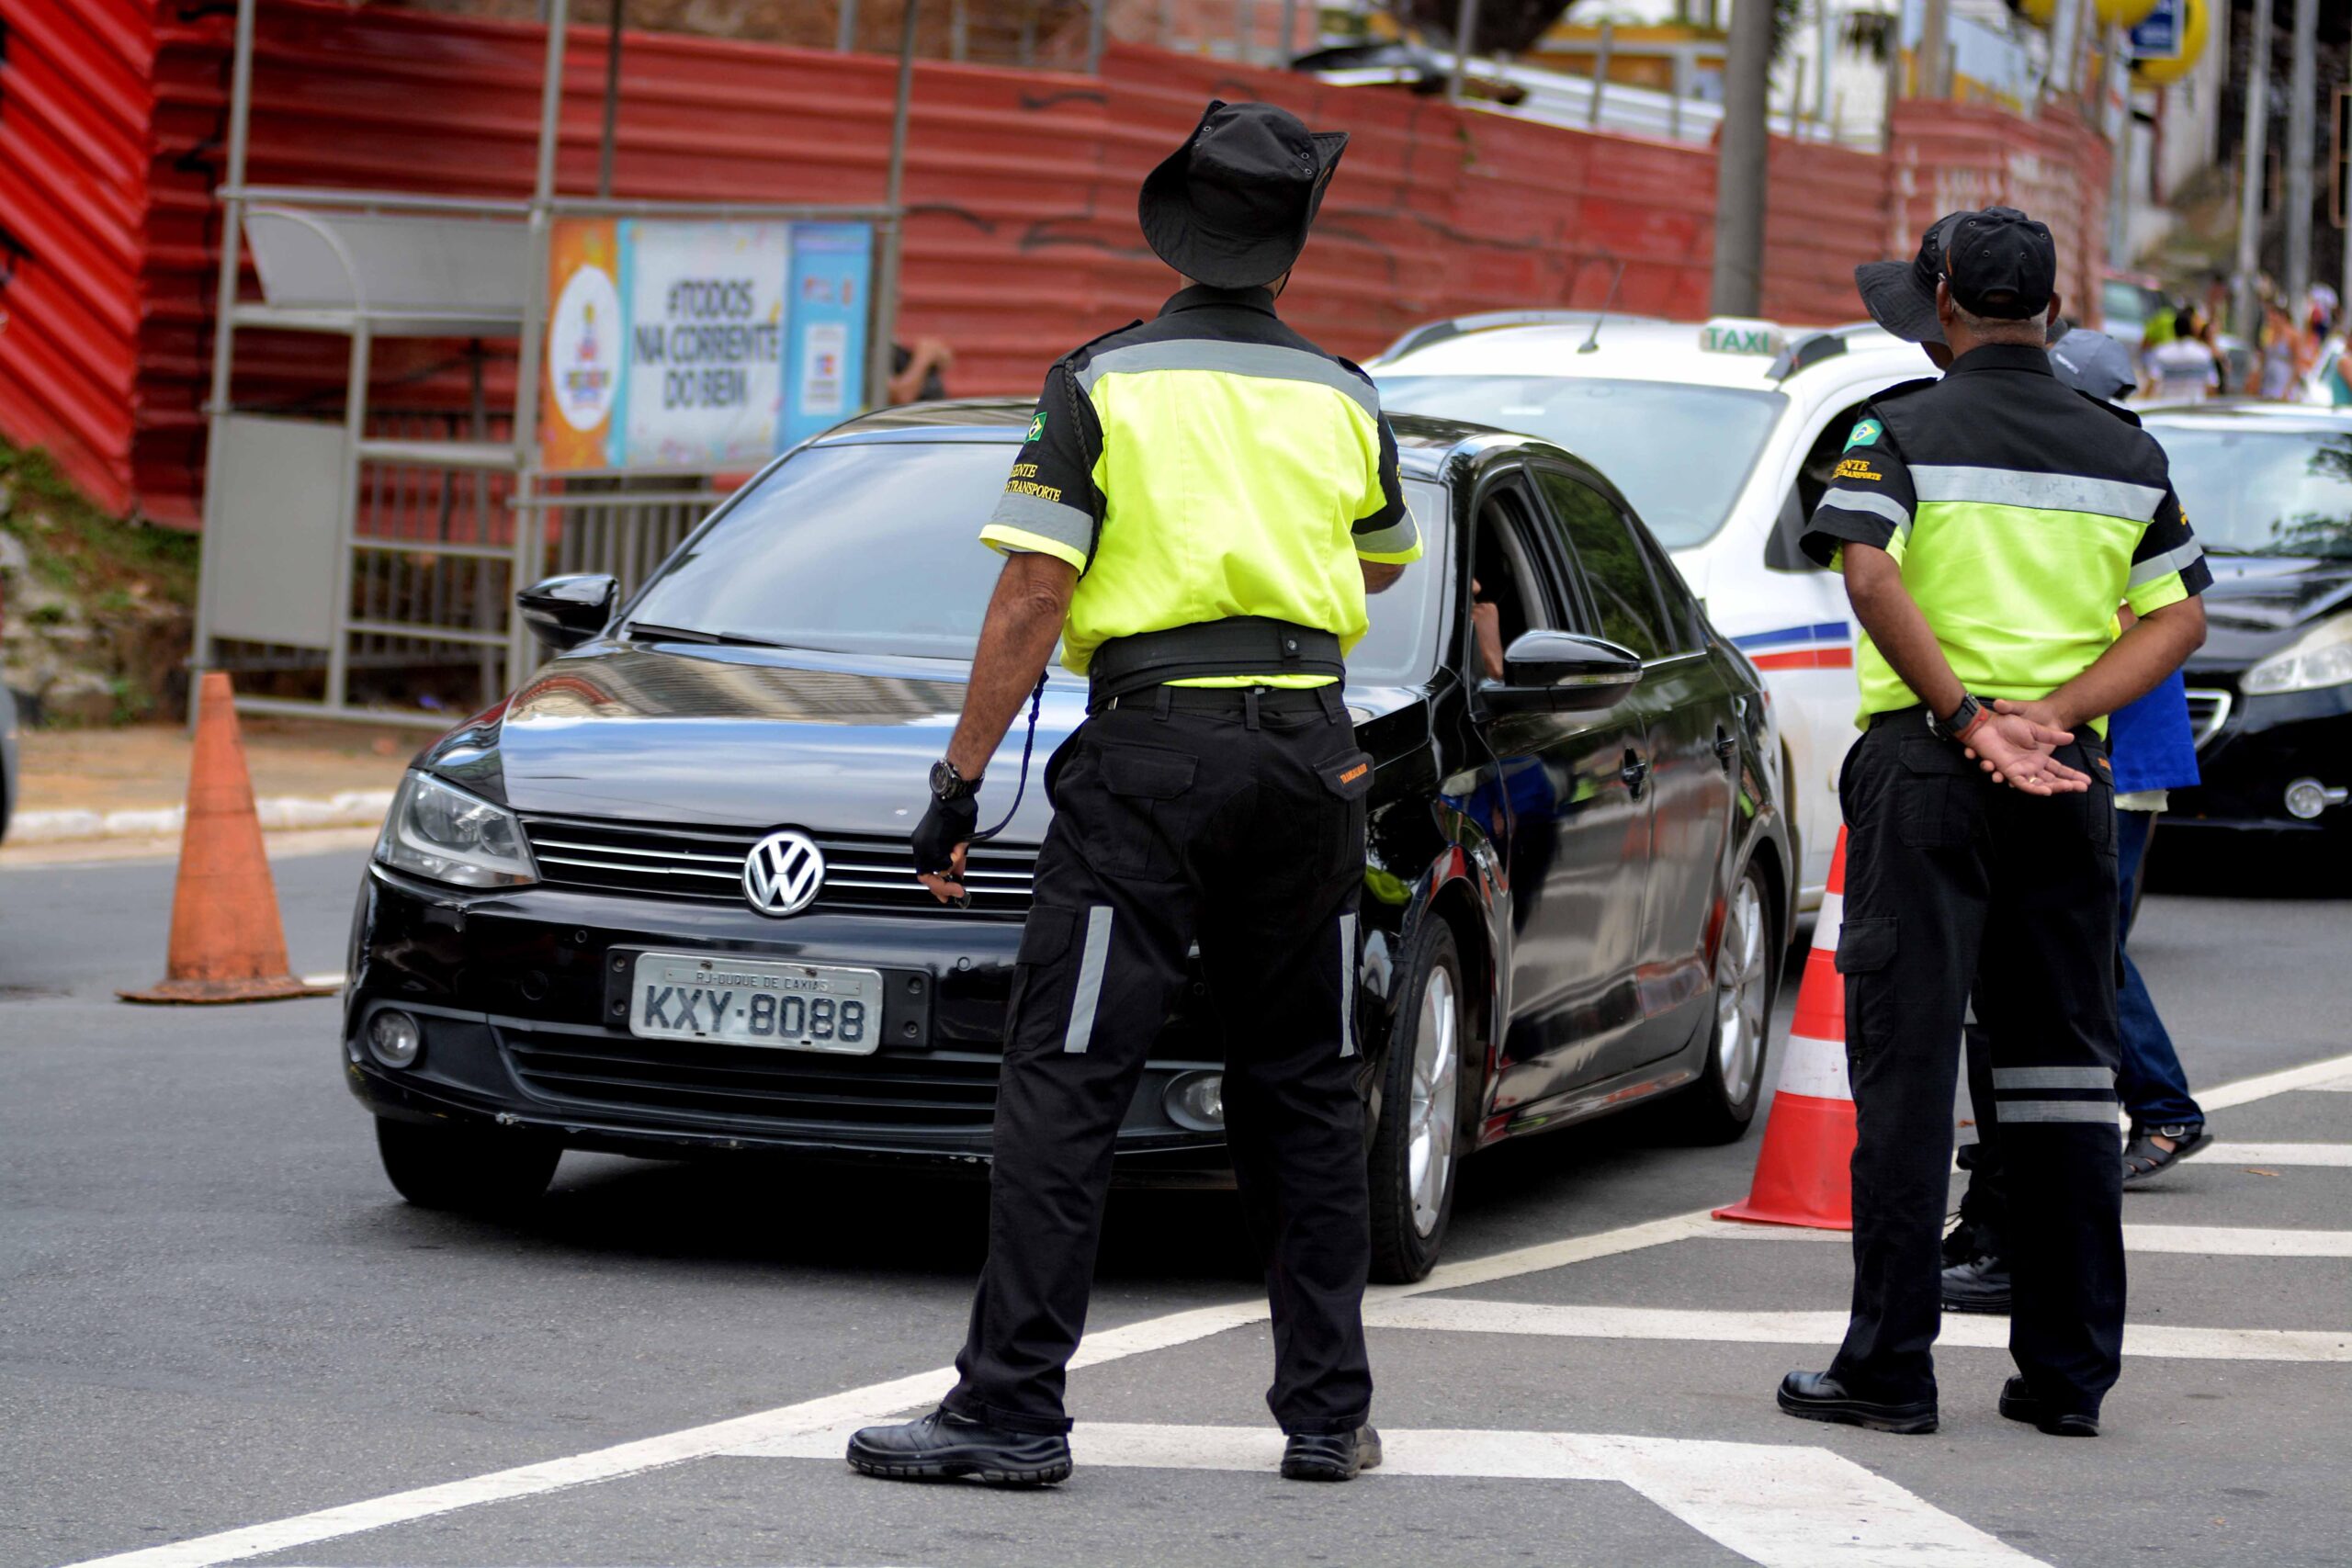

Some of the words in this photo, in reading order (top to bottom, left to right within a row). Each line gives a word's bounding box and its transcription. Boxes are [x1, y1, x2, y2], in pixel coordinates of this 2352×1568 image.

[666, 278, 754, 319] #TODOS
[633, 323, 668, 365] NA
[671, 322, 780, 364] CORRENTE
[1706, 327, 1770, 354] TAXI
[663, 369, 695, 410] DO
[700, 368, 748, 409] BEM
[1011, 479, 1062, 502] TRANSPORTE
[763, 976, 779, 988] DE
